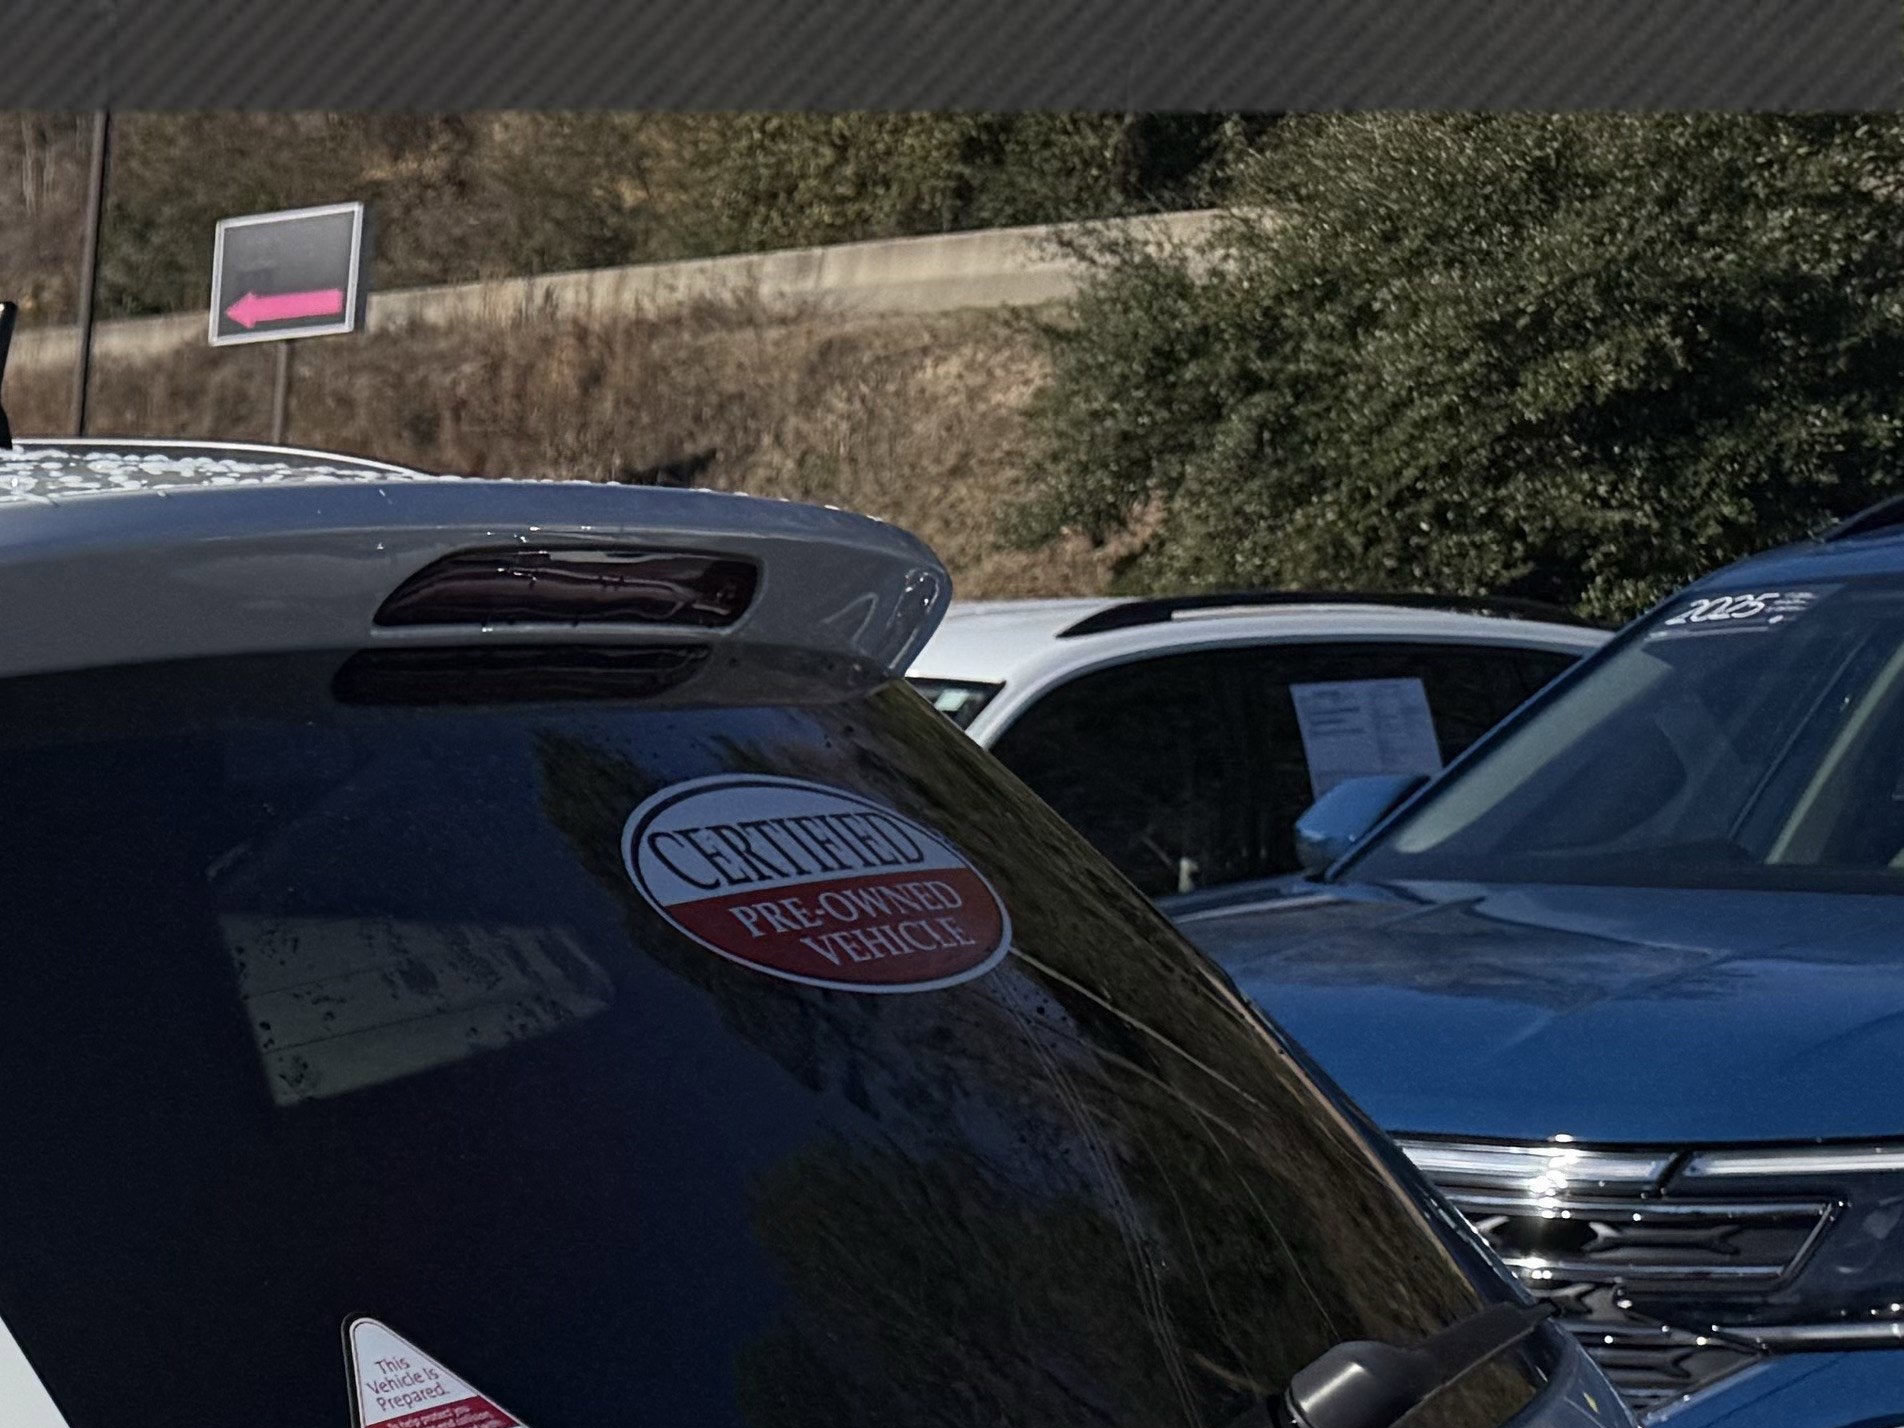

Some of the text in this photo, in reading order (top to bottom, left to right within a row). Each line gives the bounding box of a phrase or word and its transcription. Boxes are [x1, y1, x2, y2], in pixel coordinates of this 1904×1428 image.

[646, 810, 928, 890] CERTIFIED
[727, 877, 964, 940] PRE-OWNED
[800, 914, 978, 968] VEHICLE
[365, 1366, 440, 1397] Vehicle Is
[374, 1355, 411, 1378] This
[375, 1381, 450, 1412] Prepared.
